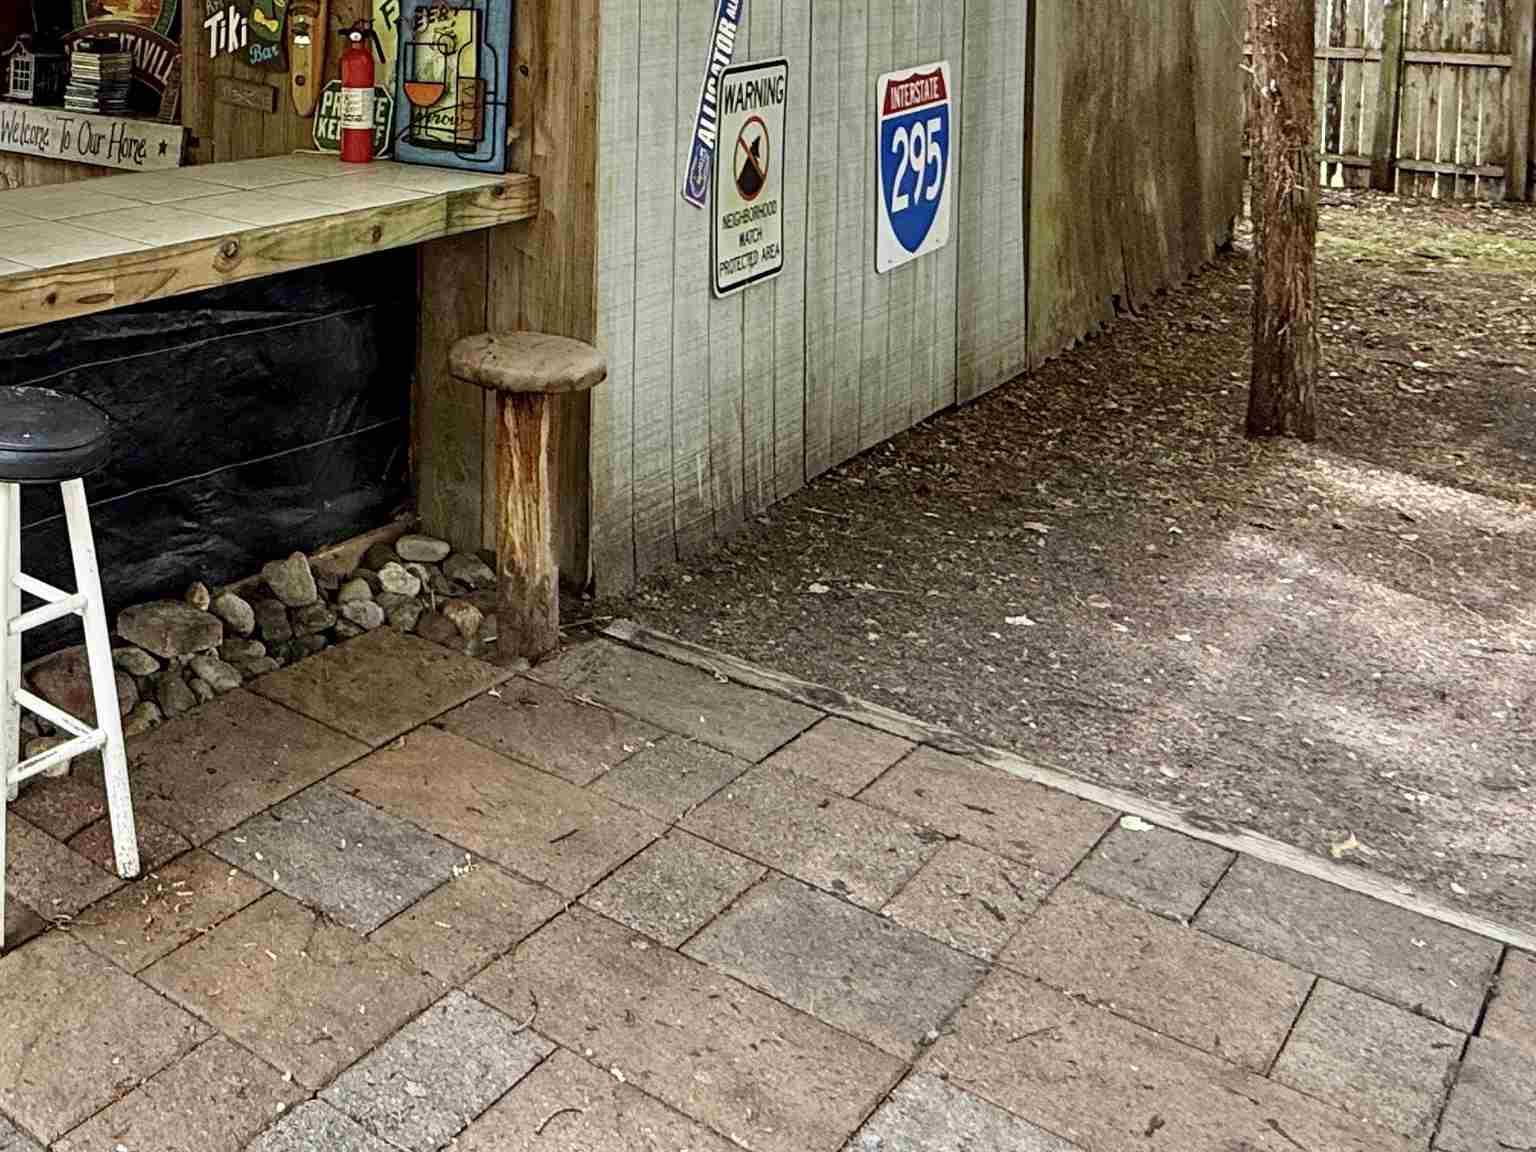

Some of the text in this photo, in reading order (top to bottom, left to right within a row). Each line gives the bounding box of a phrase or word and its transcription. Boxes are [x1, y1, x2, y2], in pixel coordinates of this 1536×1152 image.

[249, 43, 279, 65] Bar
[724, 74, 785, 115] WARNING
[890, 76, 940, 110] INTERSTATE
[0, 109, 147, 166] Welcome To Our Home
[891, 117, 943, 214] 295
[721, 199, 777, 230] NEIGHBORHOOD
[738, 227, 763, 248] WATCH
[719, 242, 781, 277] PROTECTED AREA
